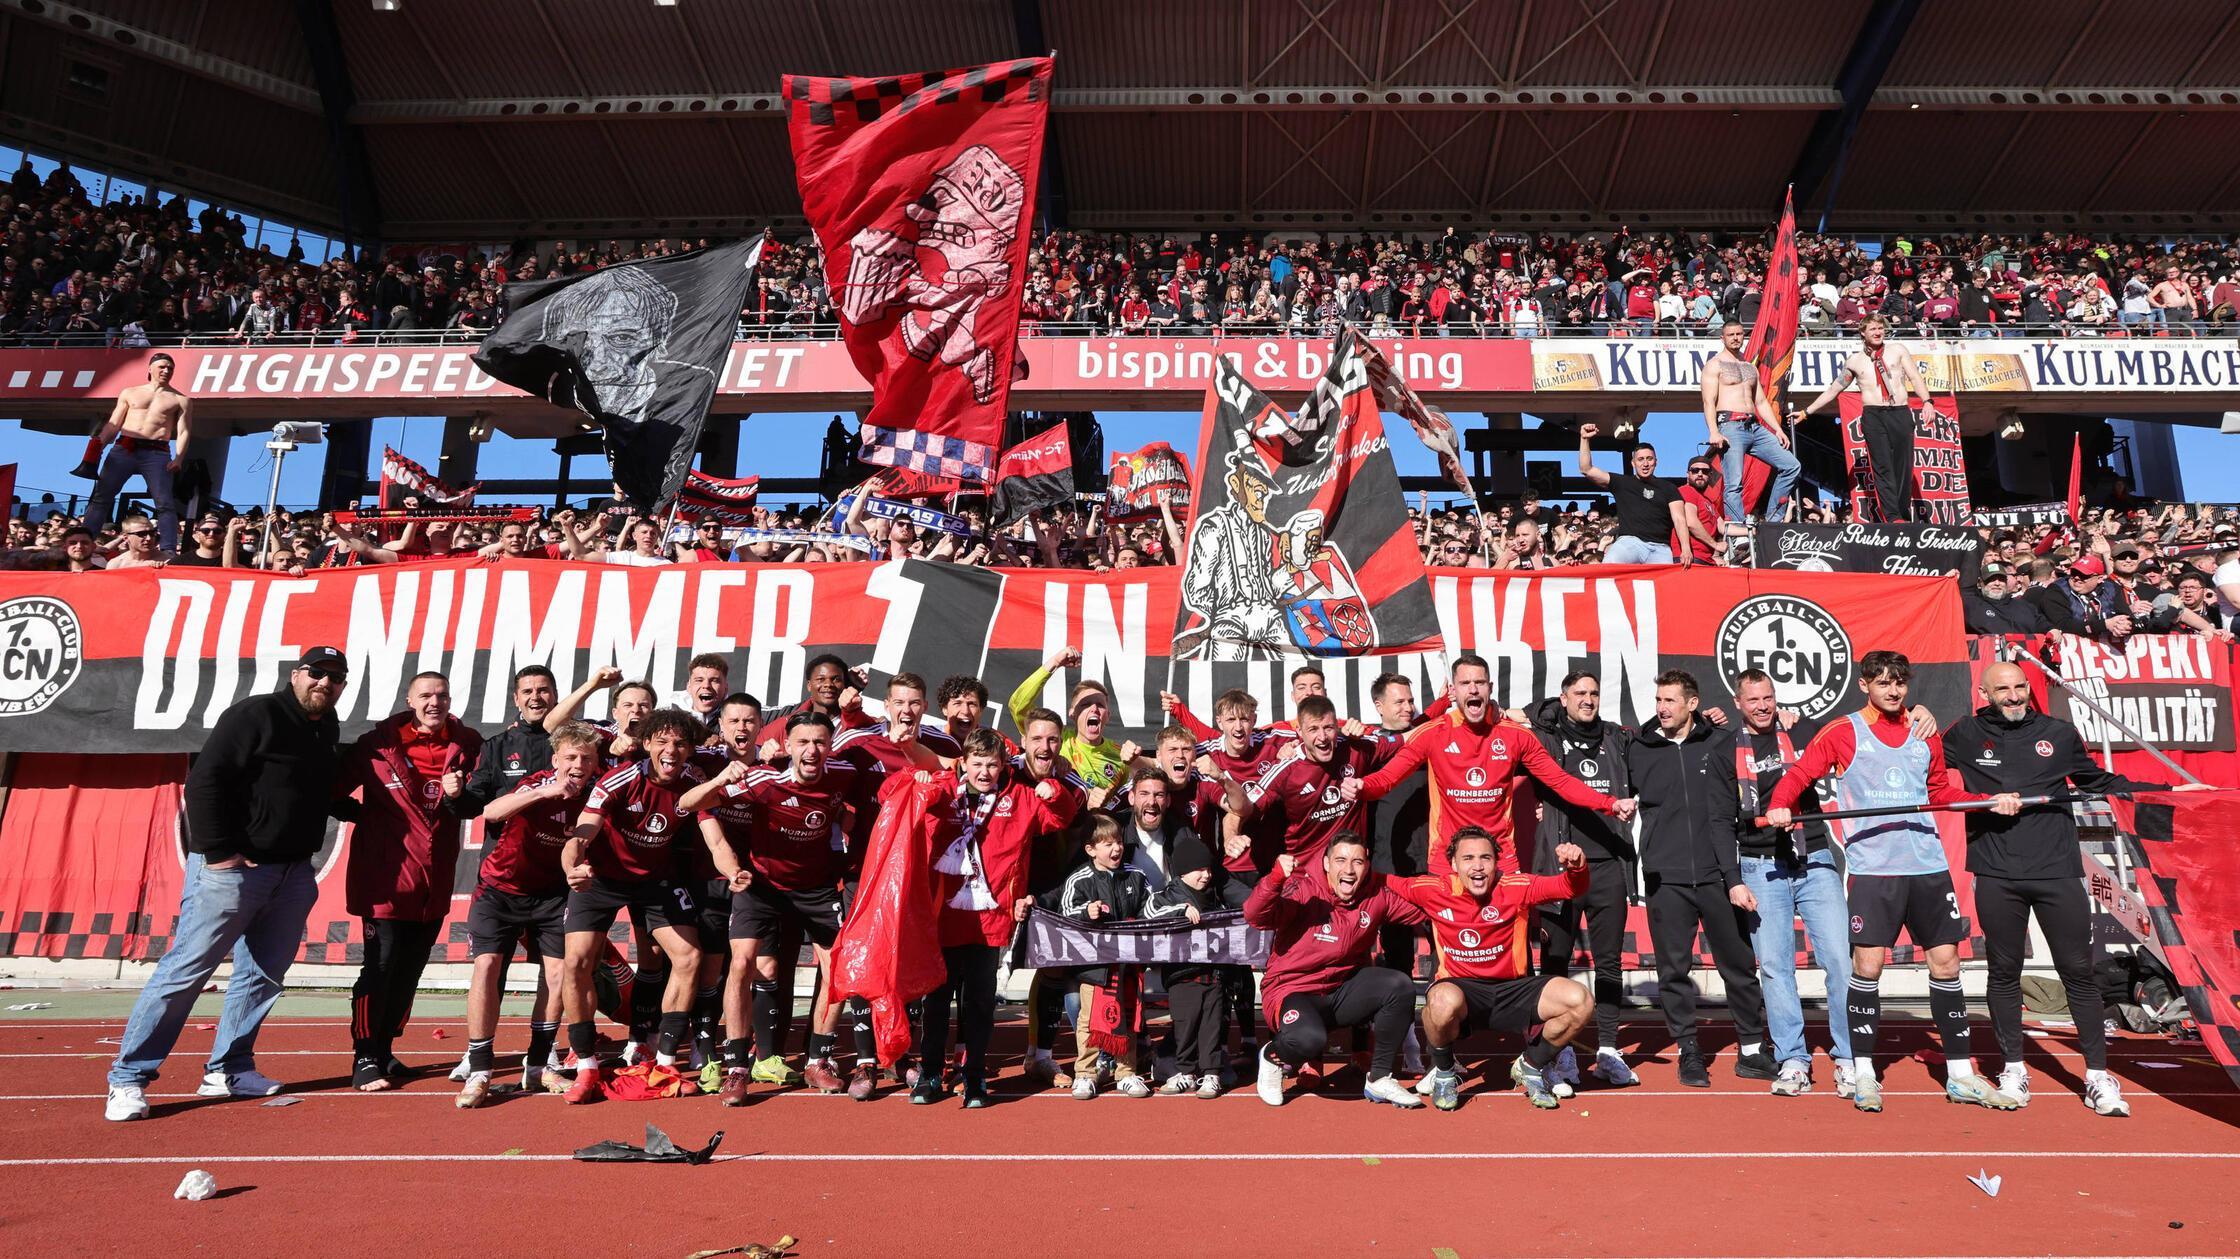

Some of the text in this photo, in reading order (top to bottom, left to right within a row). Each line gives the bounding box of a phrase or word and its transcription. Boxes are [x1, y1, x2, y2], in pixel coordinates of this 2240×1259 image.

[190, 346, 498, 393] HIGHSPEED
[1078, 341, 1463, 389] bispin & biing
[1535, 368, 1596, 389] KULMBACHER
[1961, 368, 2023, 390] KULMBACHER
[2031, 343, 2240, 386] KULMBACH
[1921, 470, 1969, 494] DIE
[1973, 511, 2020, 527] NTI
[1778, 528, 1844, 554] Hetzel
[1843, 523, 1890, 548] Ruhe
[1894, 531, 1911, 548] in
[7, 619, 32, 648] 1.
[1768, 616, 1797, 649] 1.
[134, 578, 319, 730] DIE
[337, 567, 816, 727] NUMMER
[860, 558, 1010, 738] 1
[1042, 581, 1149, 728] IN
[2060, 633, 2214, 680] RESPEKT
[0, 648, 53, 681] CN
[1746, 649, 1823, 686] FCN
[2068, 688, 2218, 743] RIVALITÄT
[1446, 787, 1503, 797] NÜRNBERGER
[1442, 944, 1504, 957] NÜRNBERGER
[1848, 1004, 1876, 1015] CLUB
